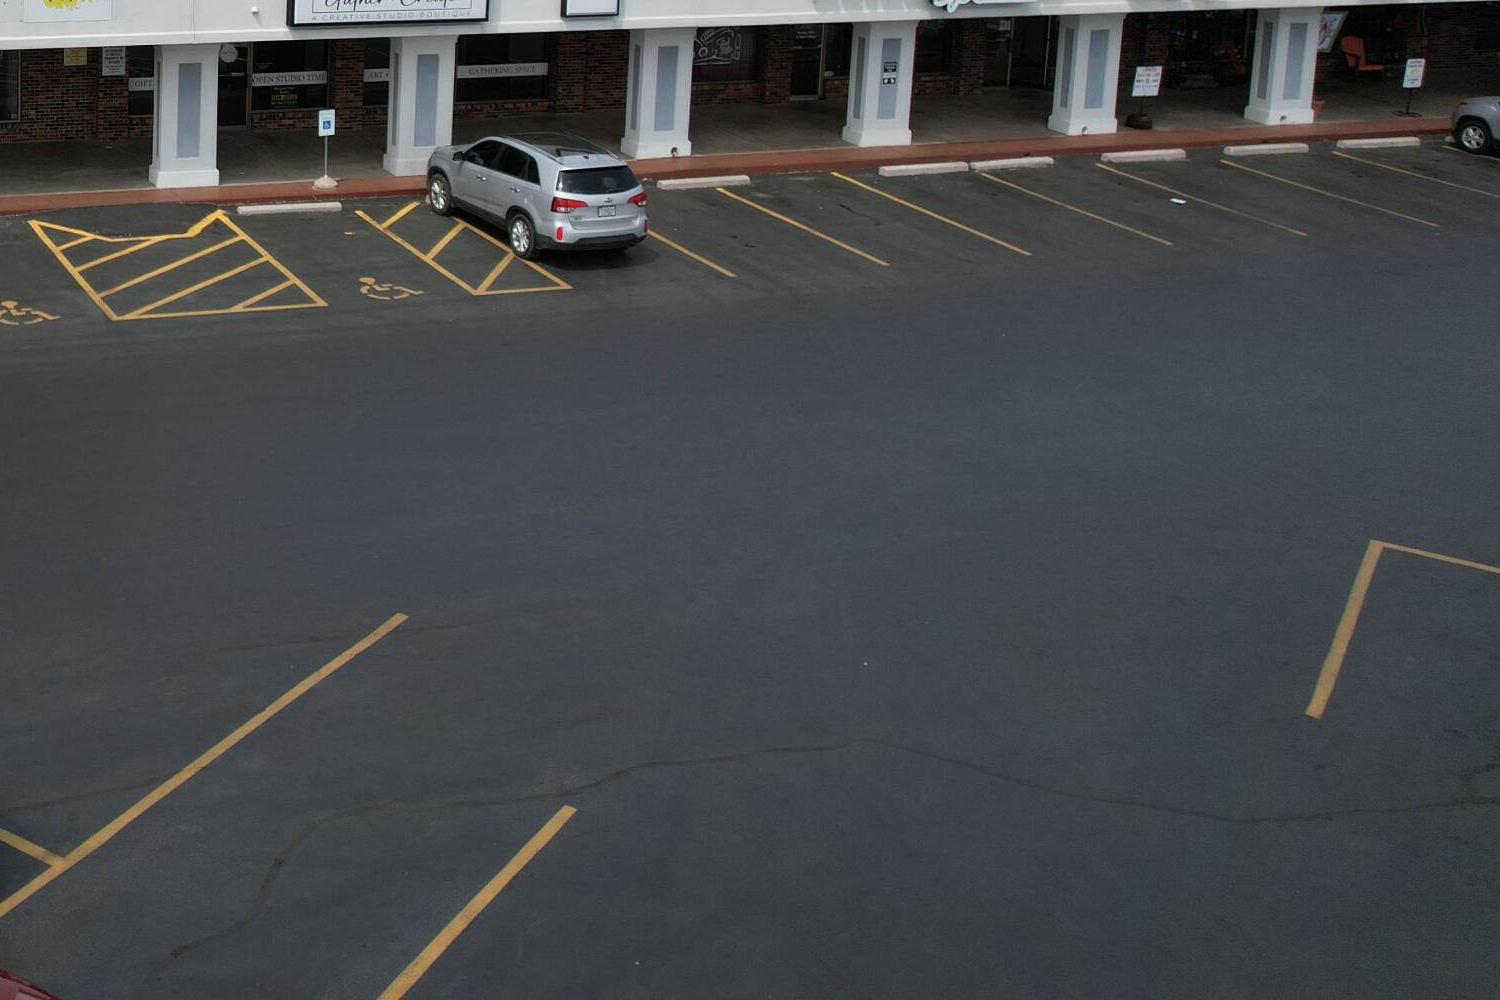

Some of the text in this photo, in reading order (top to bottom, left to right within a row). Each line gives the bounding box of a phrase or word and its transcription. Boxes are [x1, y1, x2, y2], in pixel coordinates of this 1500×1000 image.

[322, 13, 370, 21] CREATIVE
[420, 10, 471, 18] BOUTIQUE
[252, 73, 326, 84] OPEN STUDIO TIME
